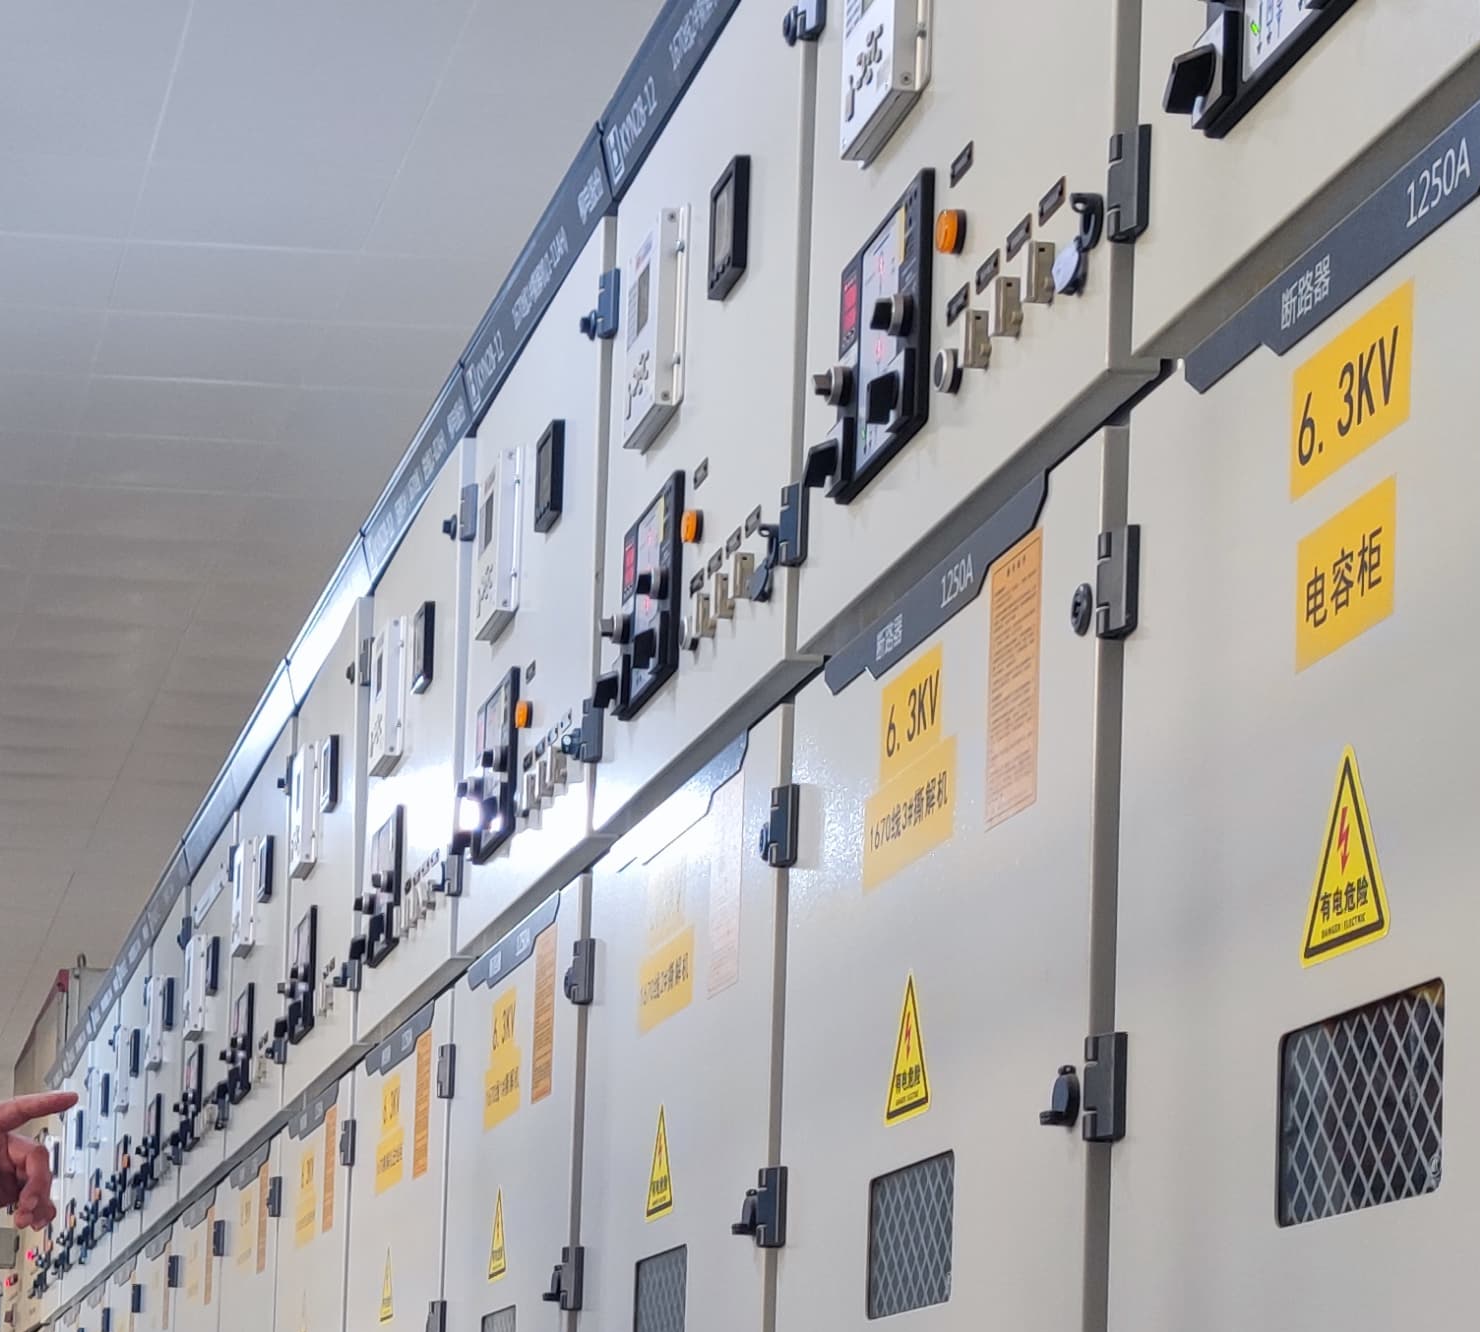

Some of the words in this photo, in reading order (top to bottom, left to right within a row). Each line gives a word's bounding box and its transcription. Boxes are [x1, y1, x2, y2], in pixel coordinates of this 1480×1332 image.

[1280, 254, 1331, 330] 断路器
[1404, 137, 1471, 229] 1250A
[1297, 325, 1400, 467] 6.3KV
[940, 554, 974, 608] 1250A
[1305, 525, 1383, 629] 电容柜
[1320, 875, 1368, 922] 有电危险
